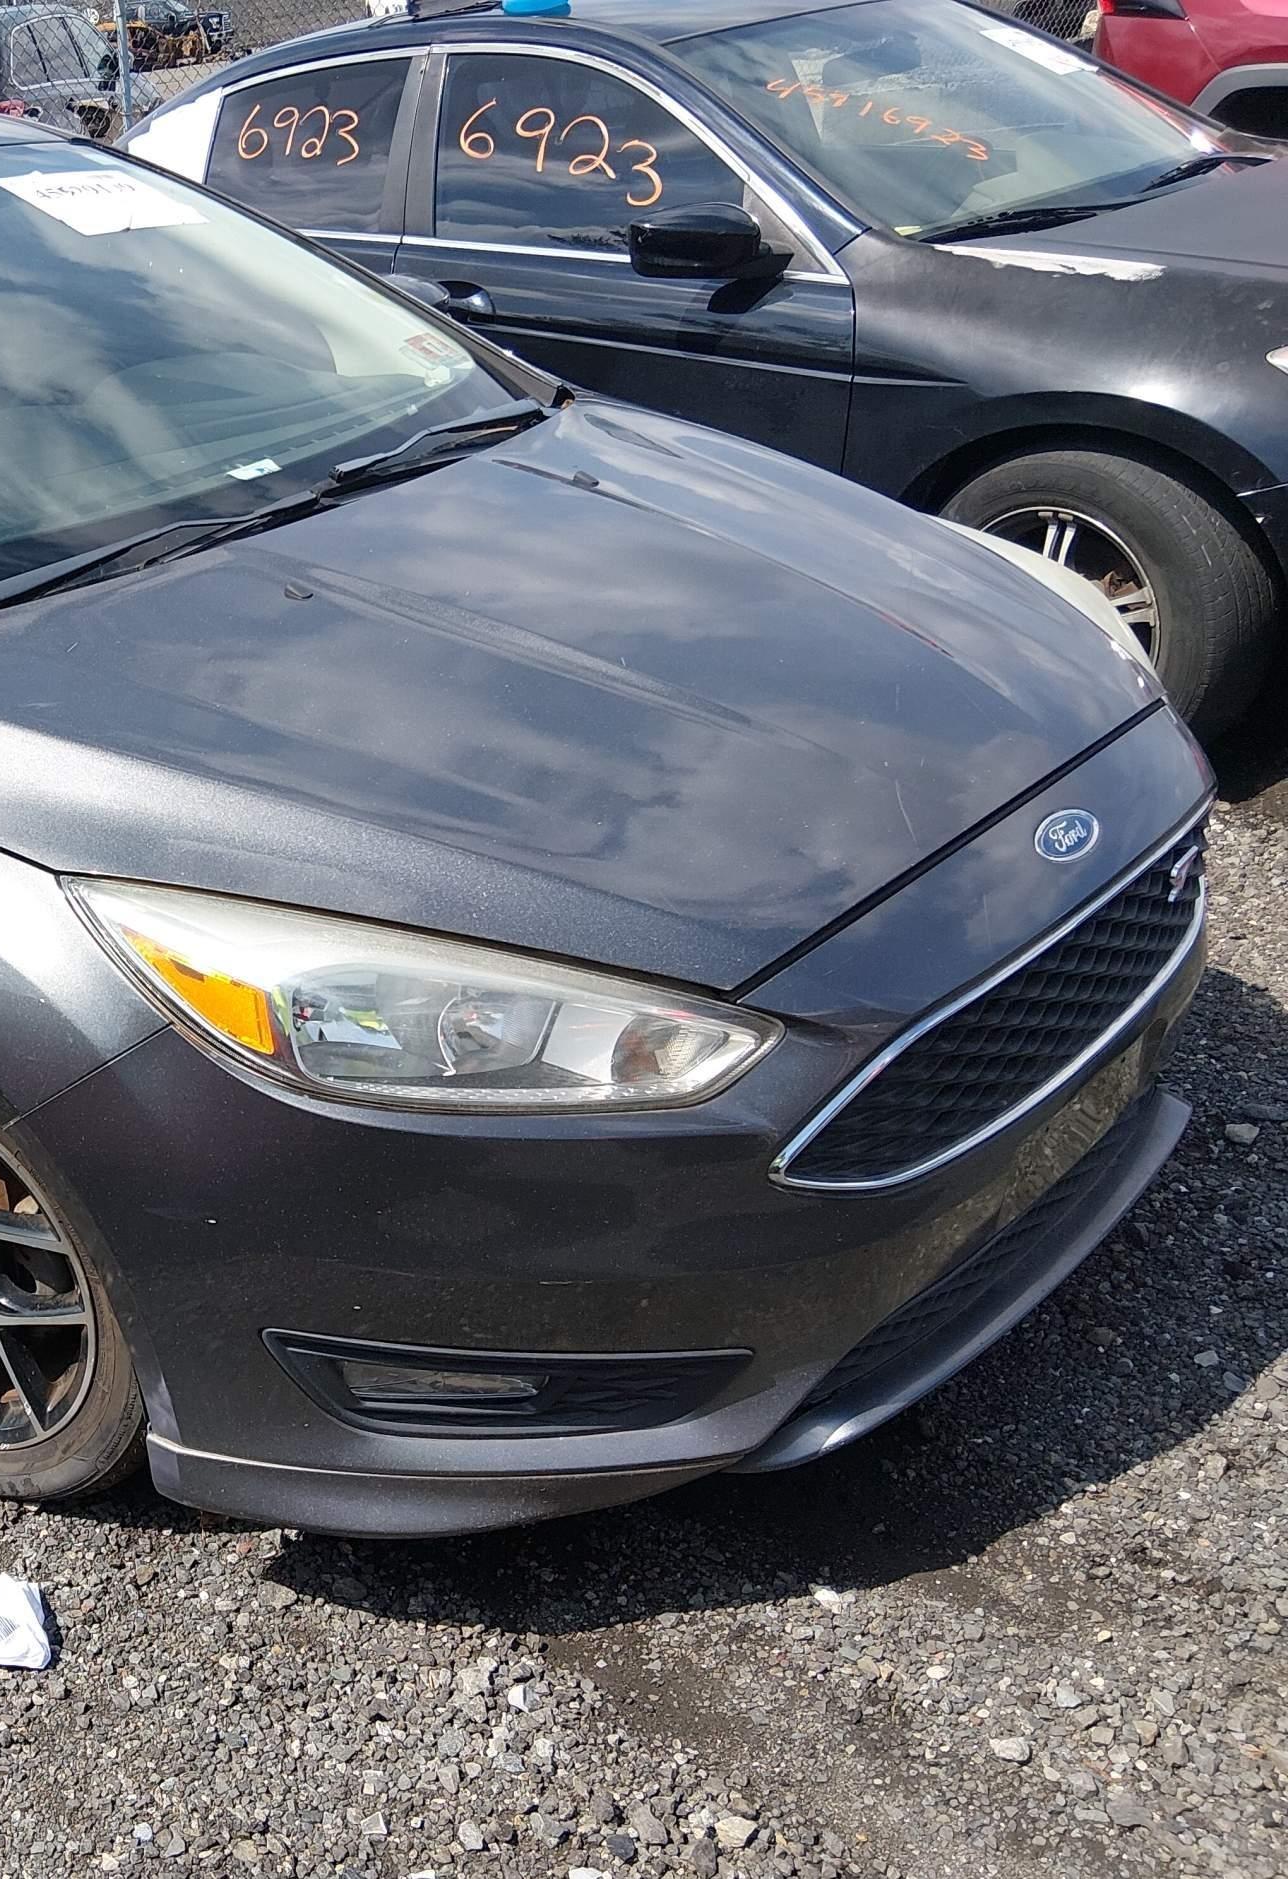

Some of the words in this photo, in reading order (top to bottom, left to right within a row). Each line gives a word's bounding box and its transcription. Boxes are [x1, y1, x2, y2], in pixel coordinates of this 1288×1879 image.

[237, 103, 360, 166] 6923
[459, 97, 664, 207] 6923
[1048, 820, 1087, 852] Ford
